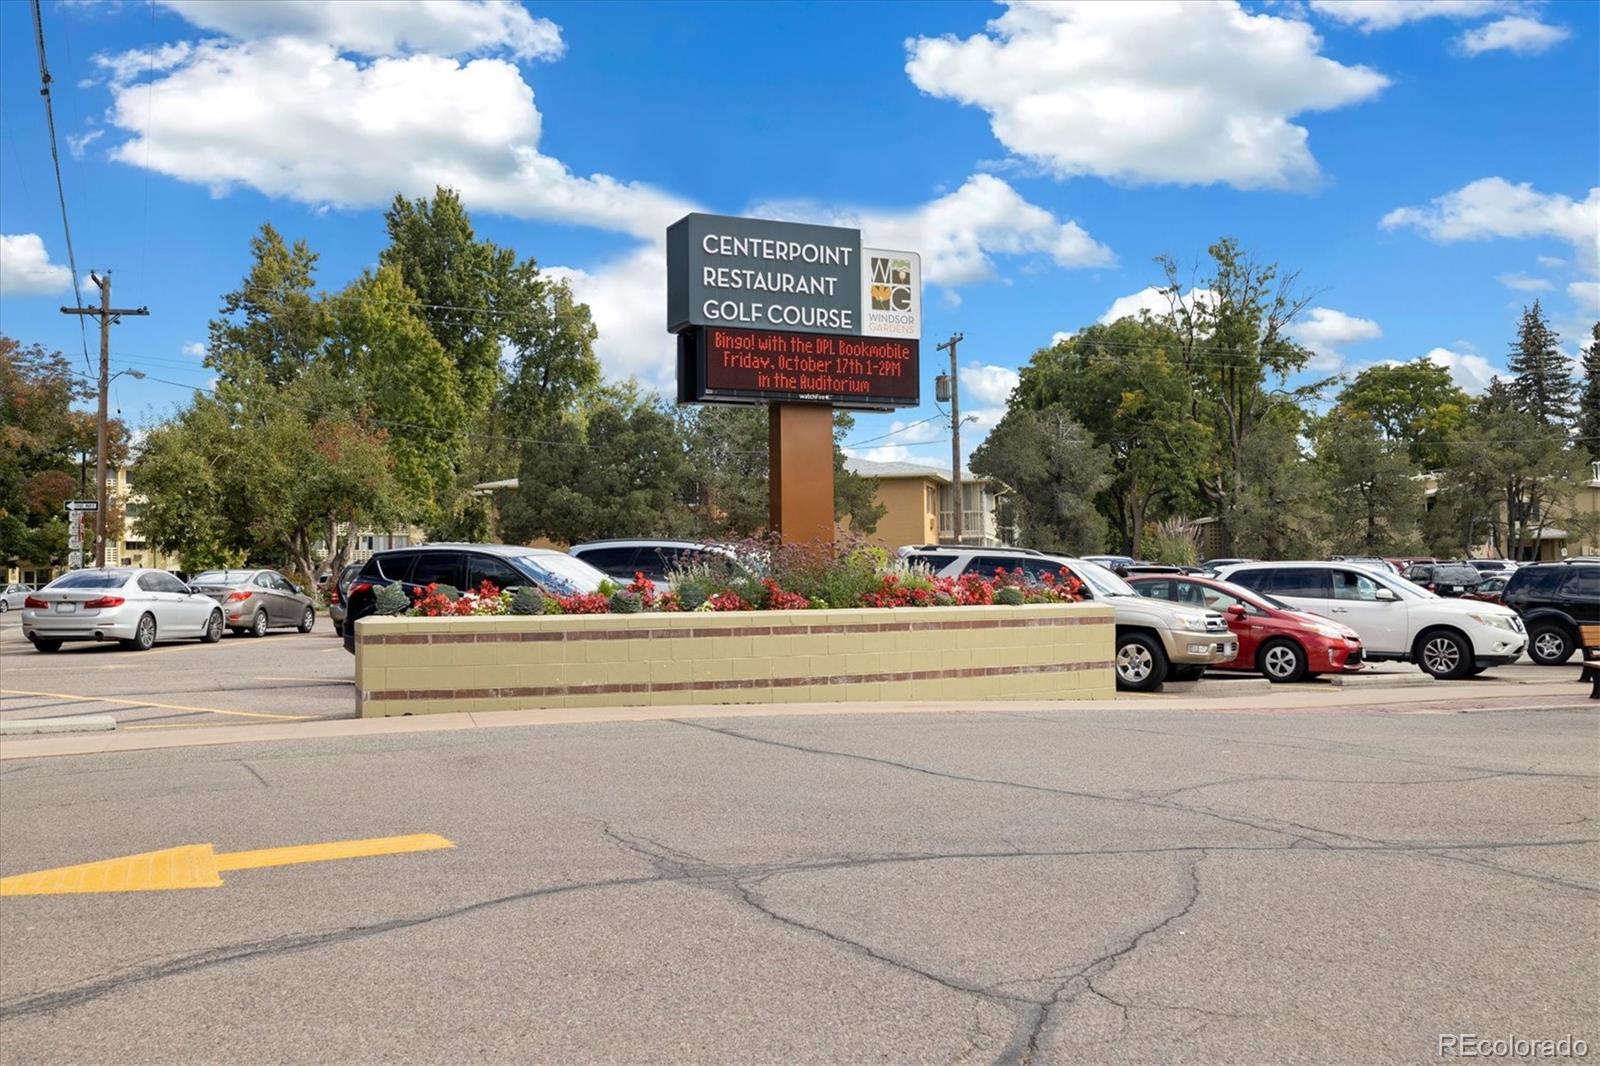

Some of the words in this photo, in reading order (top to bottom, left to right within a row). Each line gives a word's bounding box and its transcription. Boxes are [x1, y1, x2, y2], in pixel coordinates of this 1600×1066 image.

[702, 234, 852, 267] CENTERPOINT
[703, 267, 838, 296] RESTAURANT
[703, 300, 763, 322] GOLF
[767, 304, 852, 328] COURSE
[868, 313, 914, 325] WINDSOR
[868, 322, 913, 333] GARDENS
[715, 332, 755, 350] Bingo!
[758, 335, 787, 353] with
[790, 337, 813, 354] the
[839, 340, 910, 359] Bookmobile
[779, 356, 832, 372] October
[836, 358, 863, 375] 17th
[866, 360, 901, 376] 1-2PM
[758, 371, 771, 388] in
[773, 373, 798, 389] the
[800, 374, 870, 393] Auditorium
